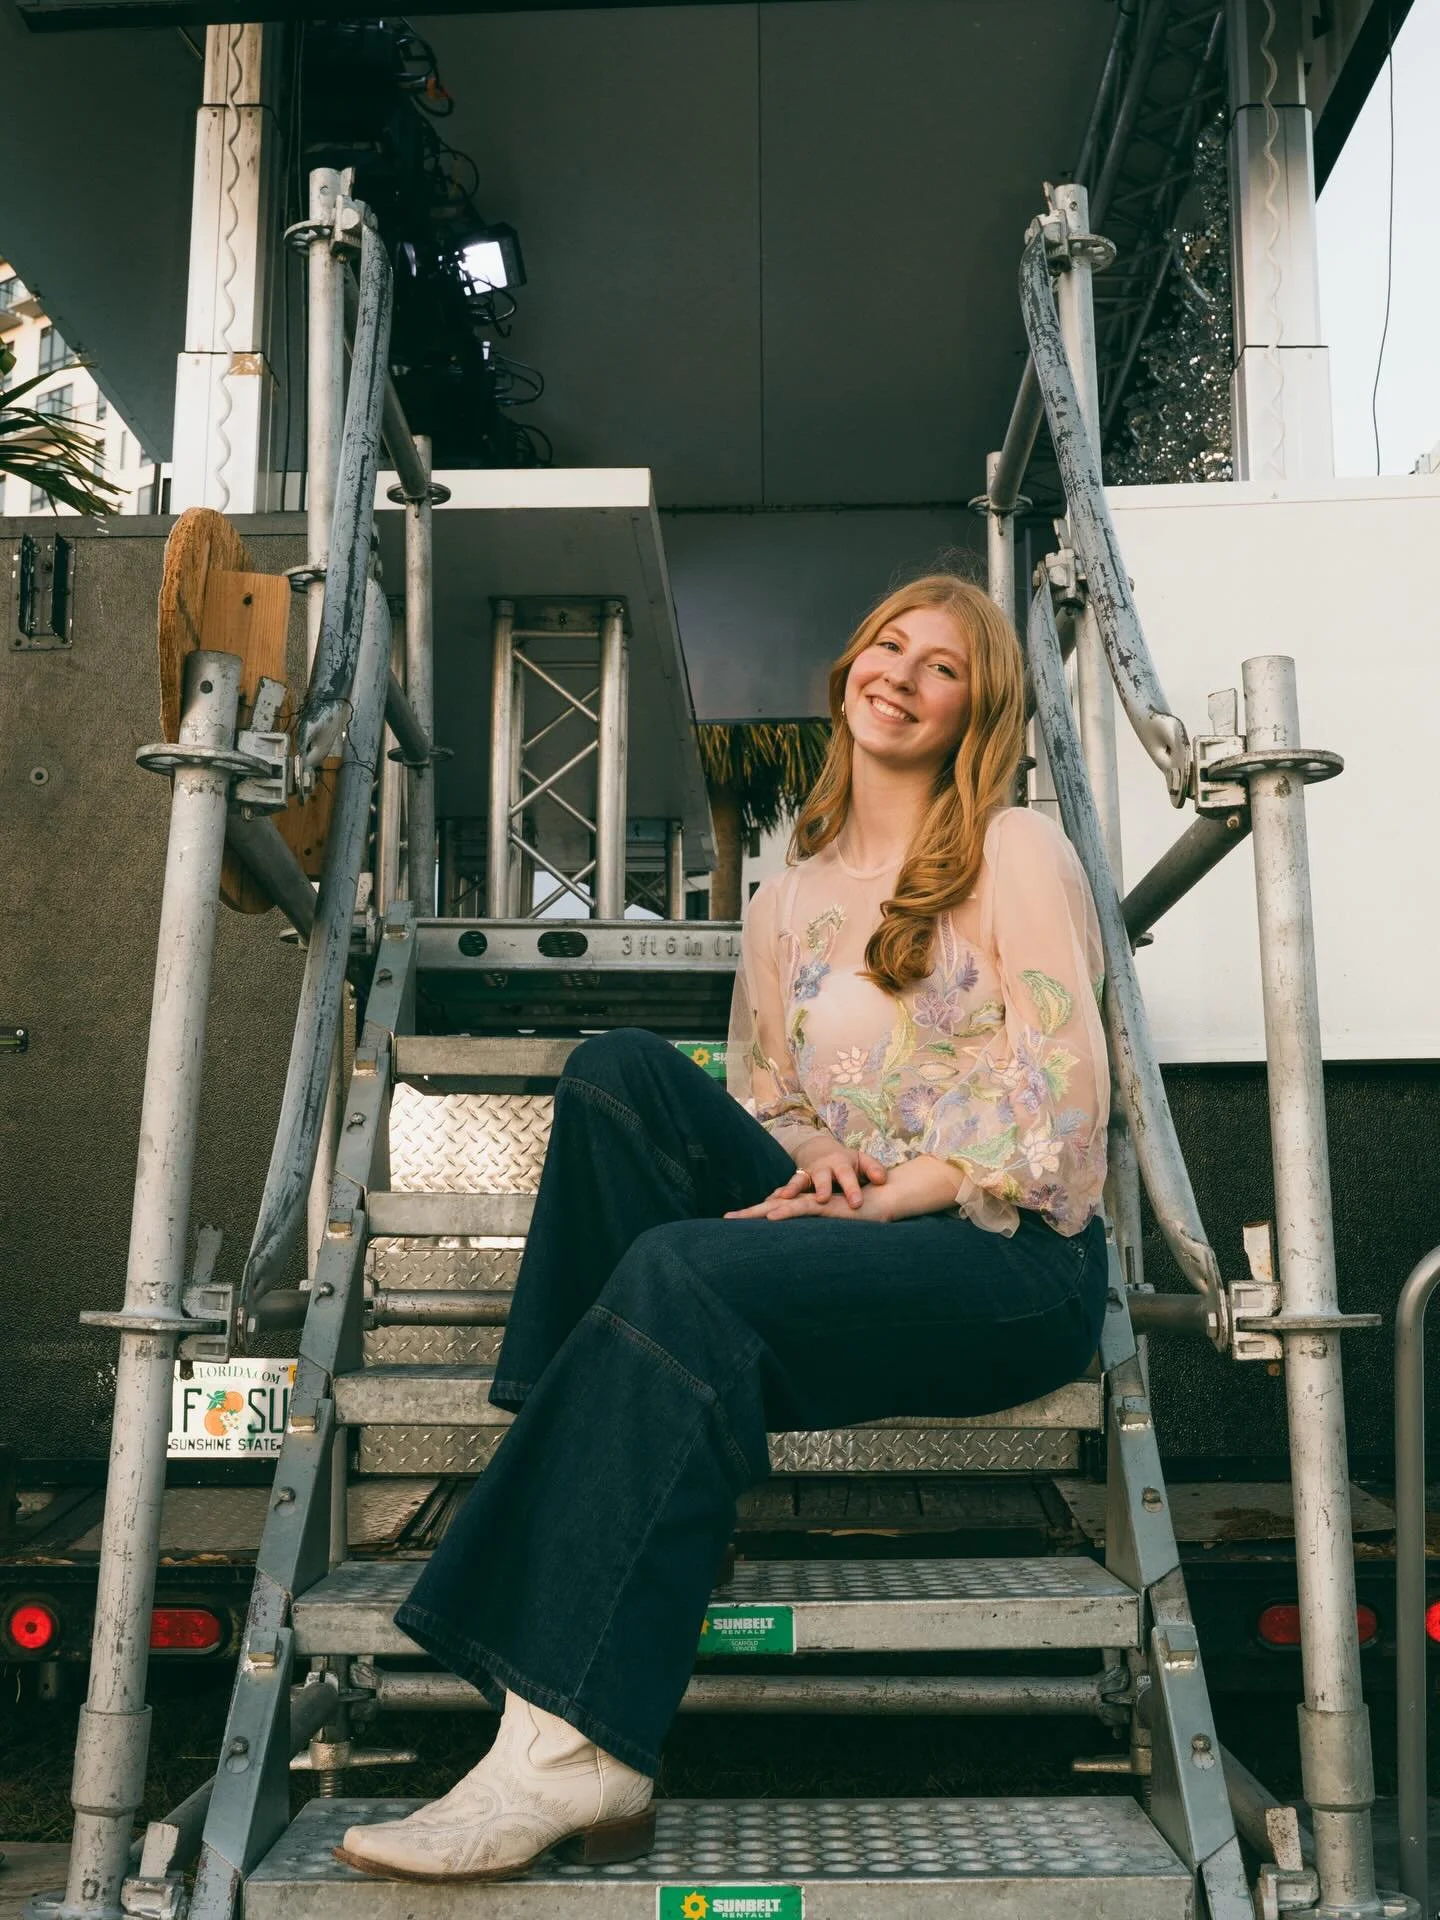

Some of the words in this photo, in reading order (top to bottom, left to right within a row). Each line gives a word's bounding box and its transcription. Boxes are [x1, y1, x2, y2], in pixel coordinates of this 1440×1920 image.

[621, 935, 632, 956] 3
[640, 935, 658, 956] ft
[665, 936, 677, 955] 6
[684, 935, 702, 956] in
[713, 935, 741, 957] (1.
[173, 1364, 281, 1384] LORIDA.COM
[170, 1438, 231, 1451] SUNSHINE
[238, 1438, 278, 1451] STATE
[713, 1617, 775, 1630] SUNBELT
[712, 1899, 781, 1912] SUNBELT
